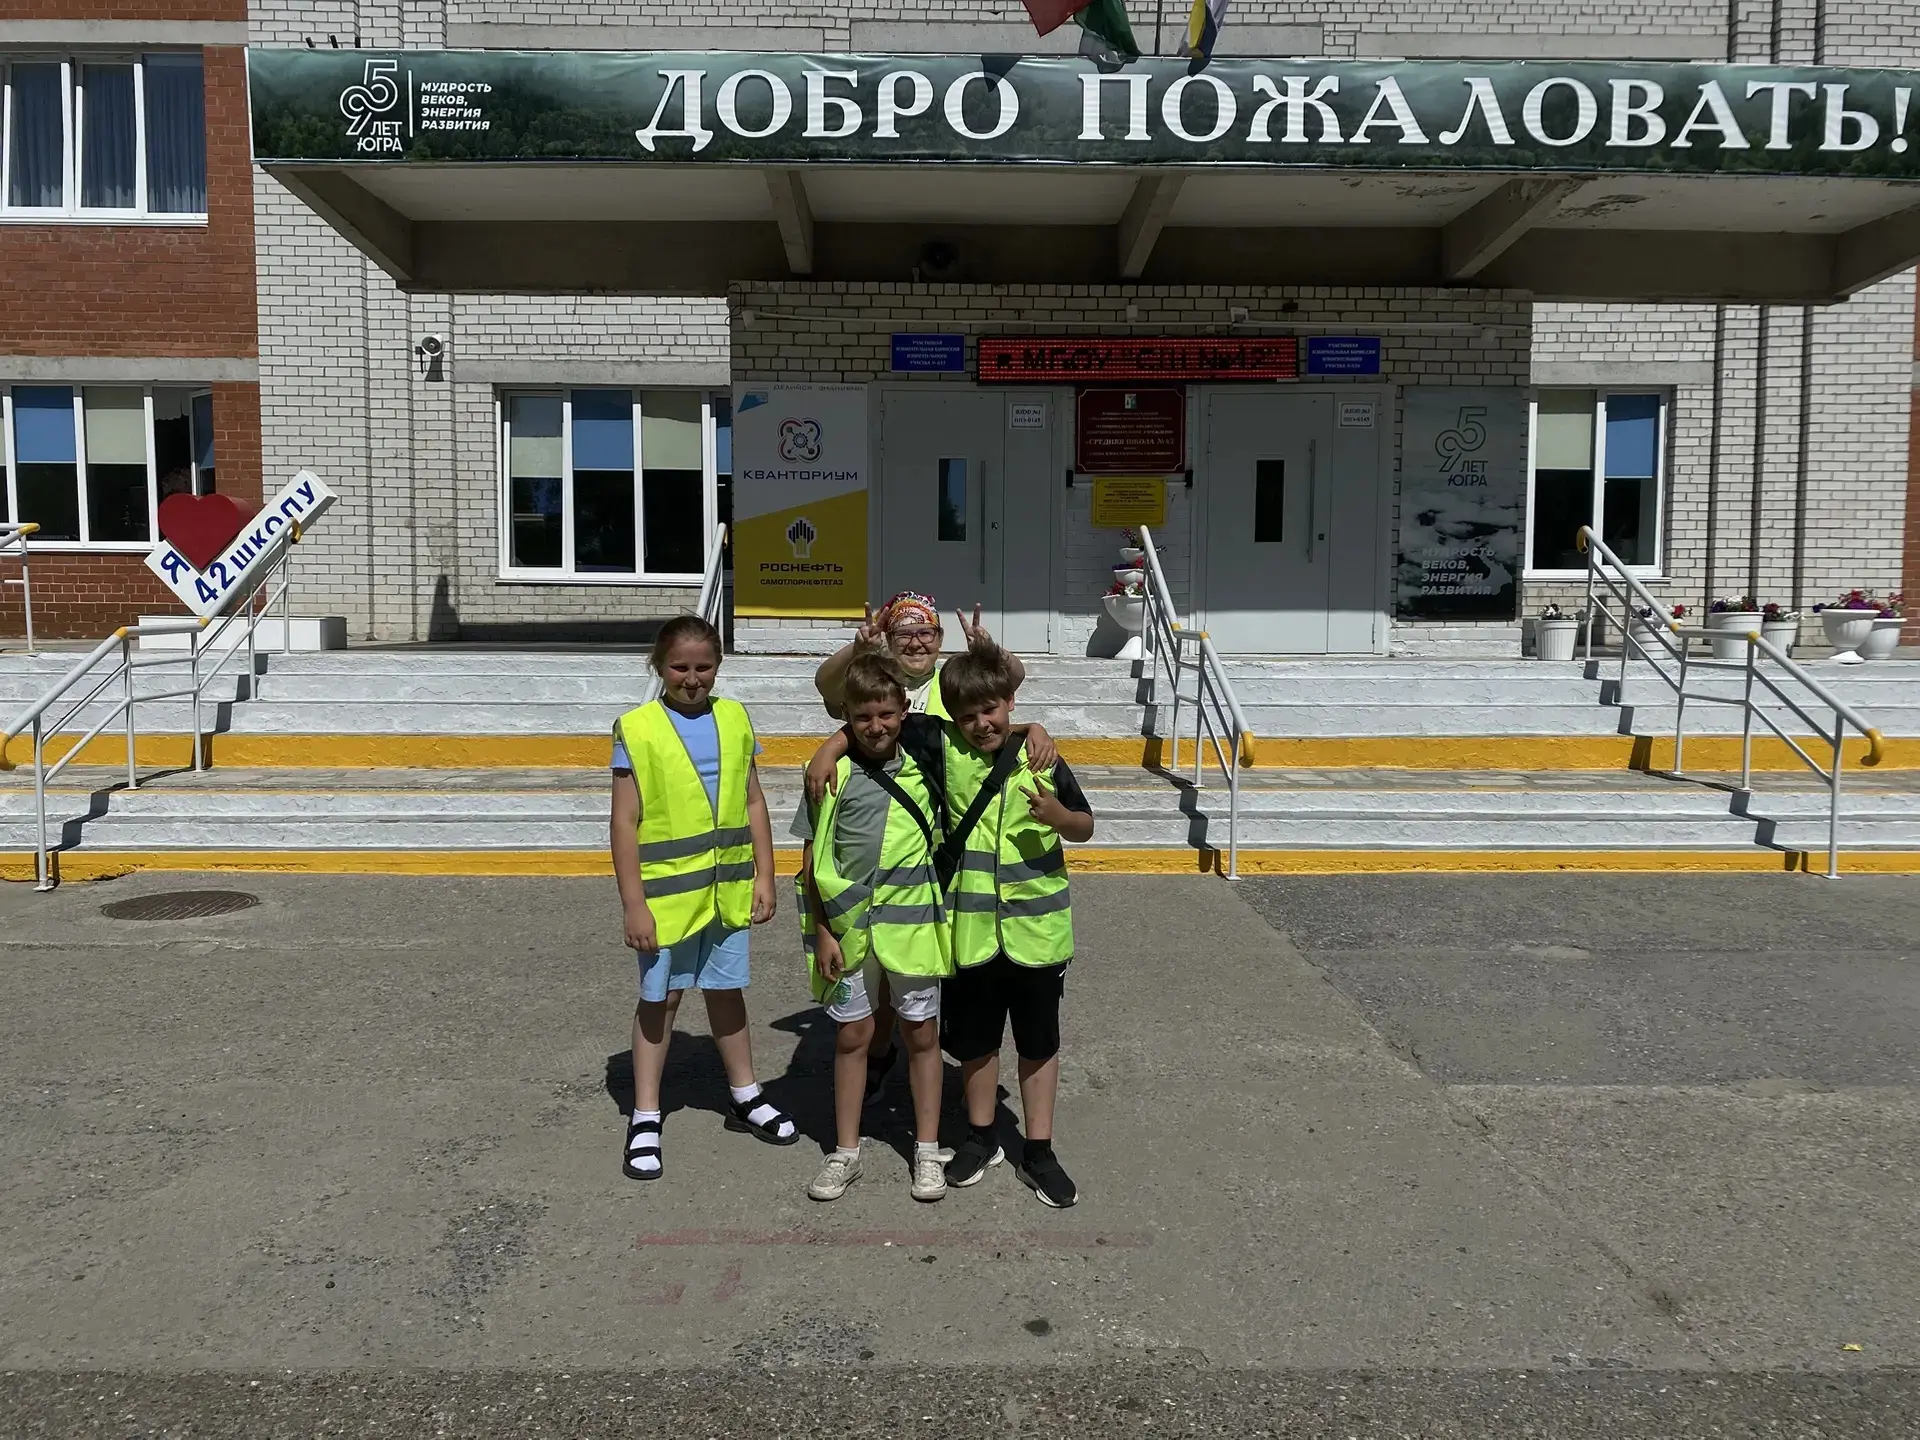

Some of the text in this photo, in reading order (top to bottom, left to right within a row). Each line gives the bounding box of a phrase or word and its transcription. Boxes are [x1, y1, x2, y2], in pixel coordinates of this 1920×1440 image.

[421, 82, 492, 94] МУДРОСТЬ
[340, 59, 403, 136] 95 ЛЕТ
[421, 95, 468, 107] ВЕКОВ,
[421, 107, 482, 118] ЭНЕРГИЯ
[635, 69, 1913, 155] ДОБРО ПОЖАЛОВАТЬ!
[421, 120, 491, 131] РАЗВИТИЯ
[356, 137, 403, 152] ЮГРА
[1459, 460, 1489, 473] ЛЕТ
[743, 470, 858, 481] КВАНТОРИУМ
[1447, 474, 1488, 487] ЮГРА
[160, 550, 191, 585] Я
[760, 563, 844, 572] РОСНЕФТЬ
[1421, 560, 1470, 570] ВЕКОВ,
[194, 561, 236, 604] 42
[760, 578, 844, 586] САМОТЛОРНЕФТЕГАЗ
[1421, 573, 1484, 582] ЭНЕРГИЯ
[1421, 585, 1492, 595] РАЗВИТИЯ
